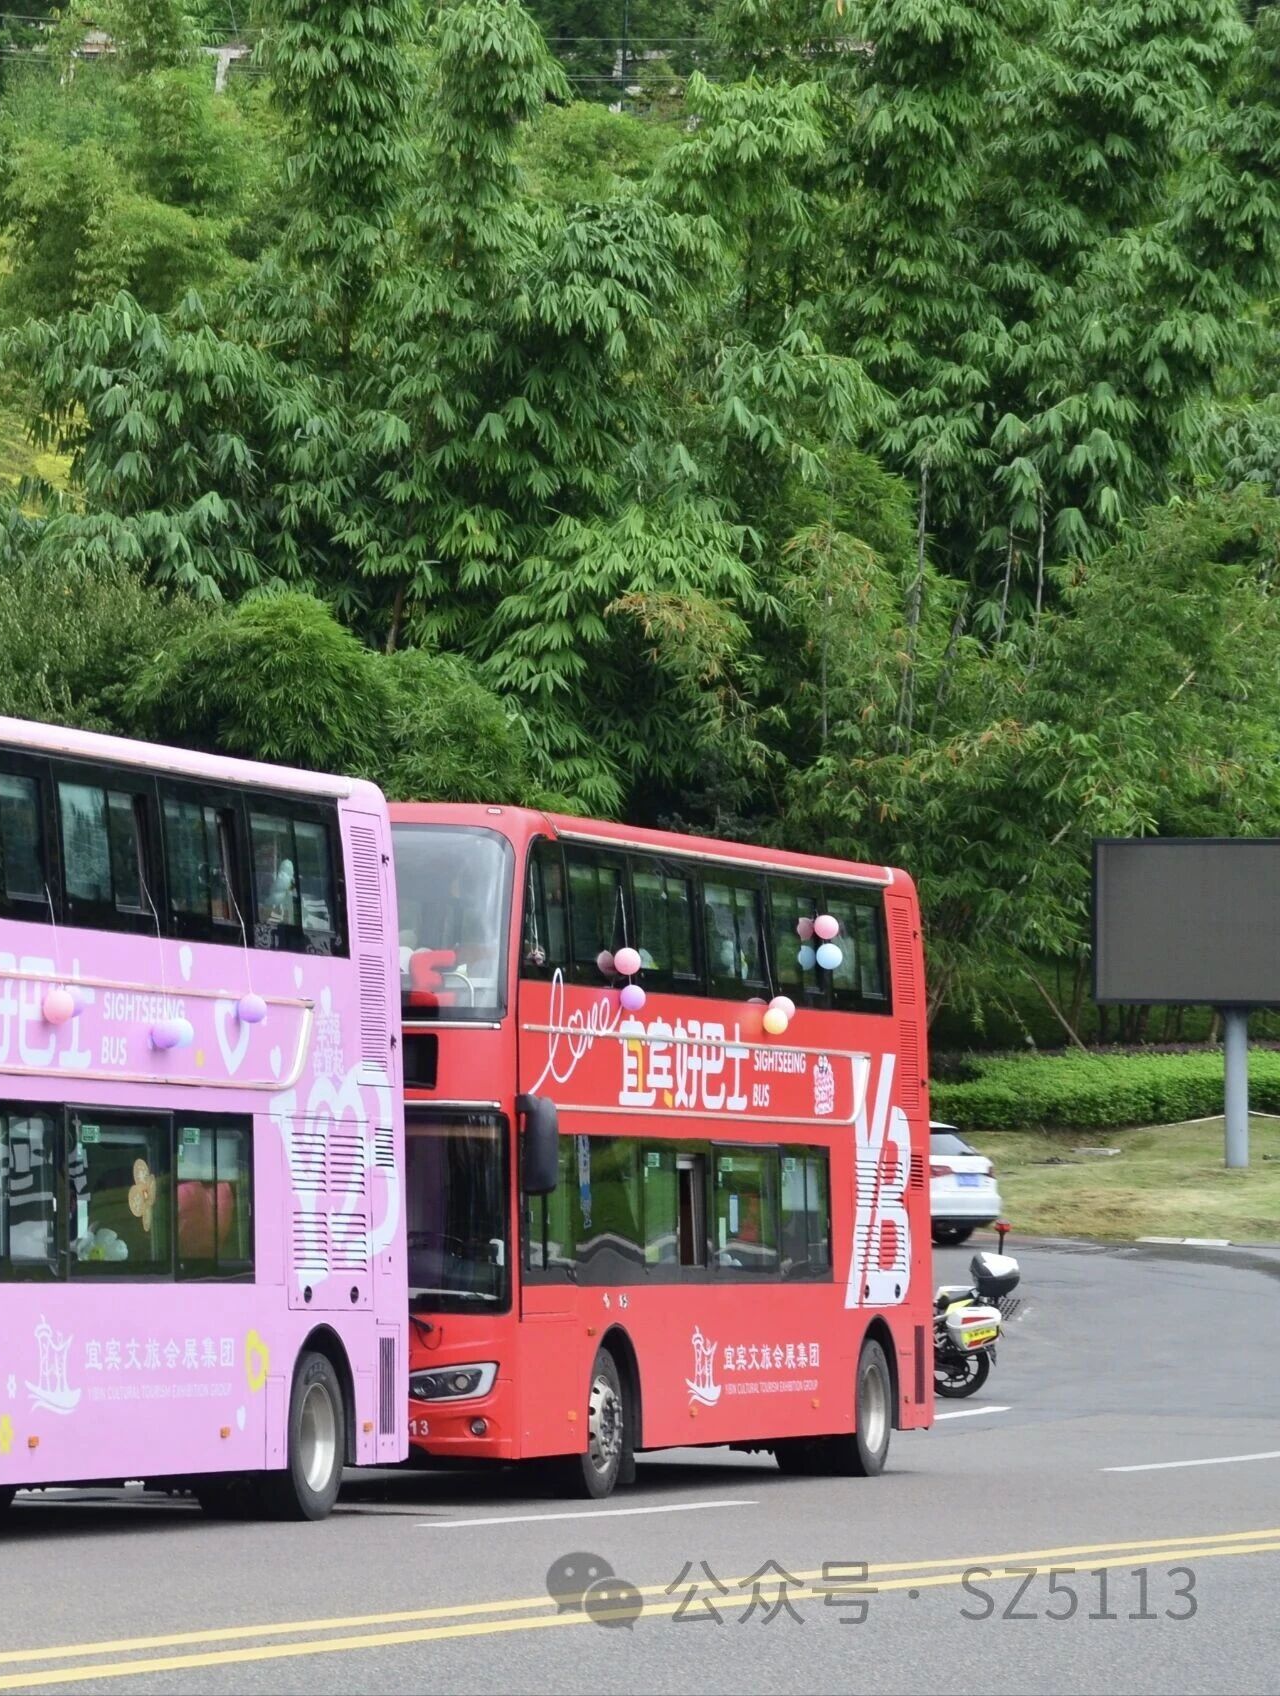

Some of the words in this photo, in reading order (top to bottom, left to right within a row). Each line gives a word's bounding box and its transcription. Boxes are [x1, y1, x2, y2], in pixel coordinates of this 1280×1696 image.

[103, 991, 186, 1025] SIGHTSEEING
[100, 1036, 128, 1066] BUS
[753, 1051, 807, 1075] SIGHTSEEING
[752, 1083, 770, 1108] BUS
[84, 1337, 236, 1371] 宜宾文旅会展集团
[723, 1342, 820, 1371] 宜宾文旅会展集团
[408, 1419, 430, 1436] 13
